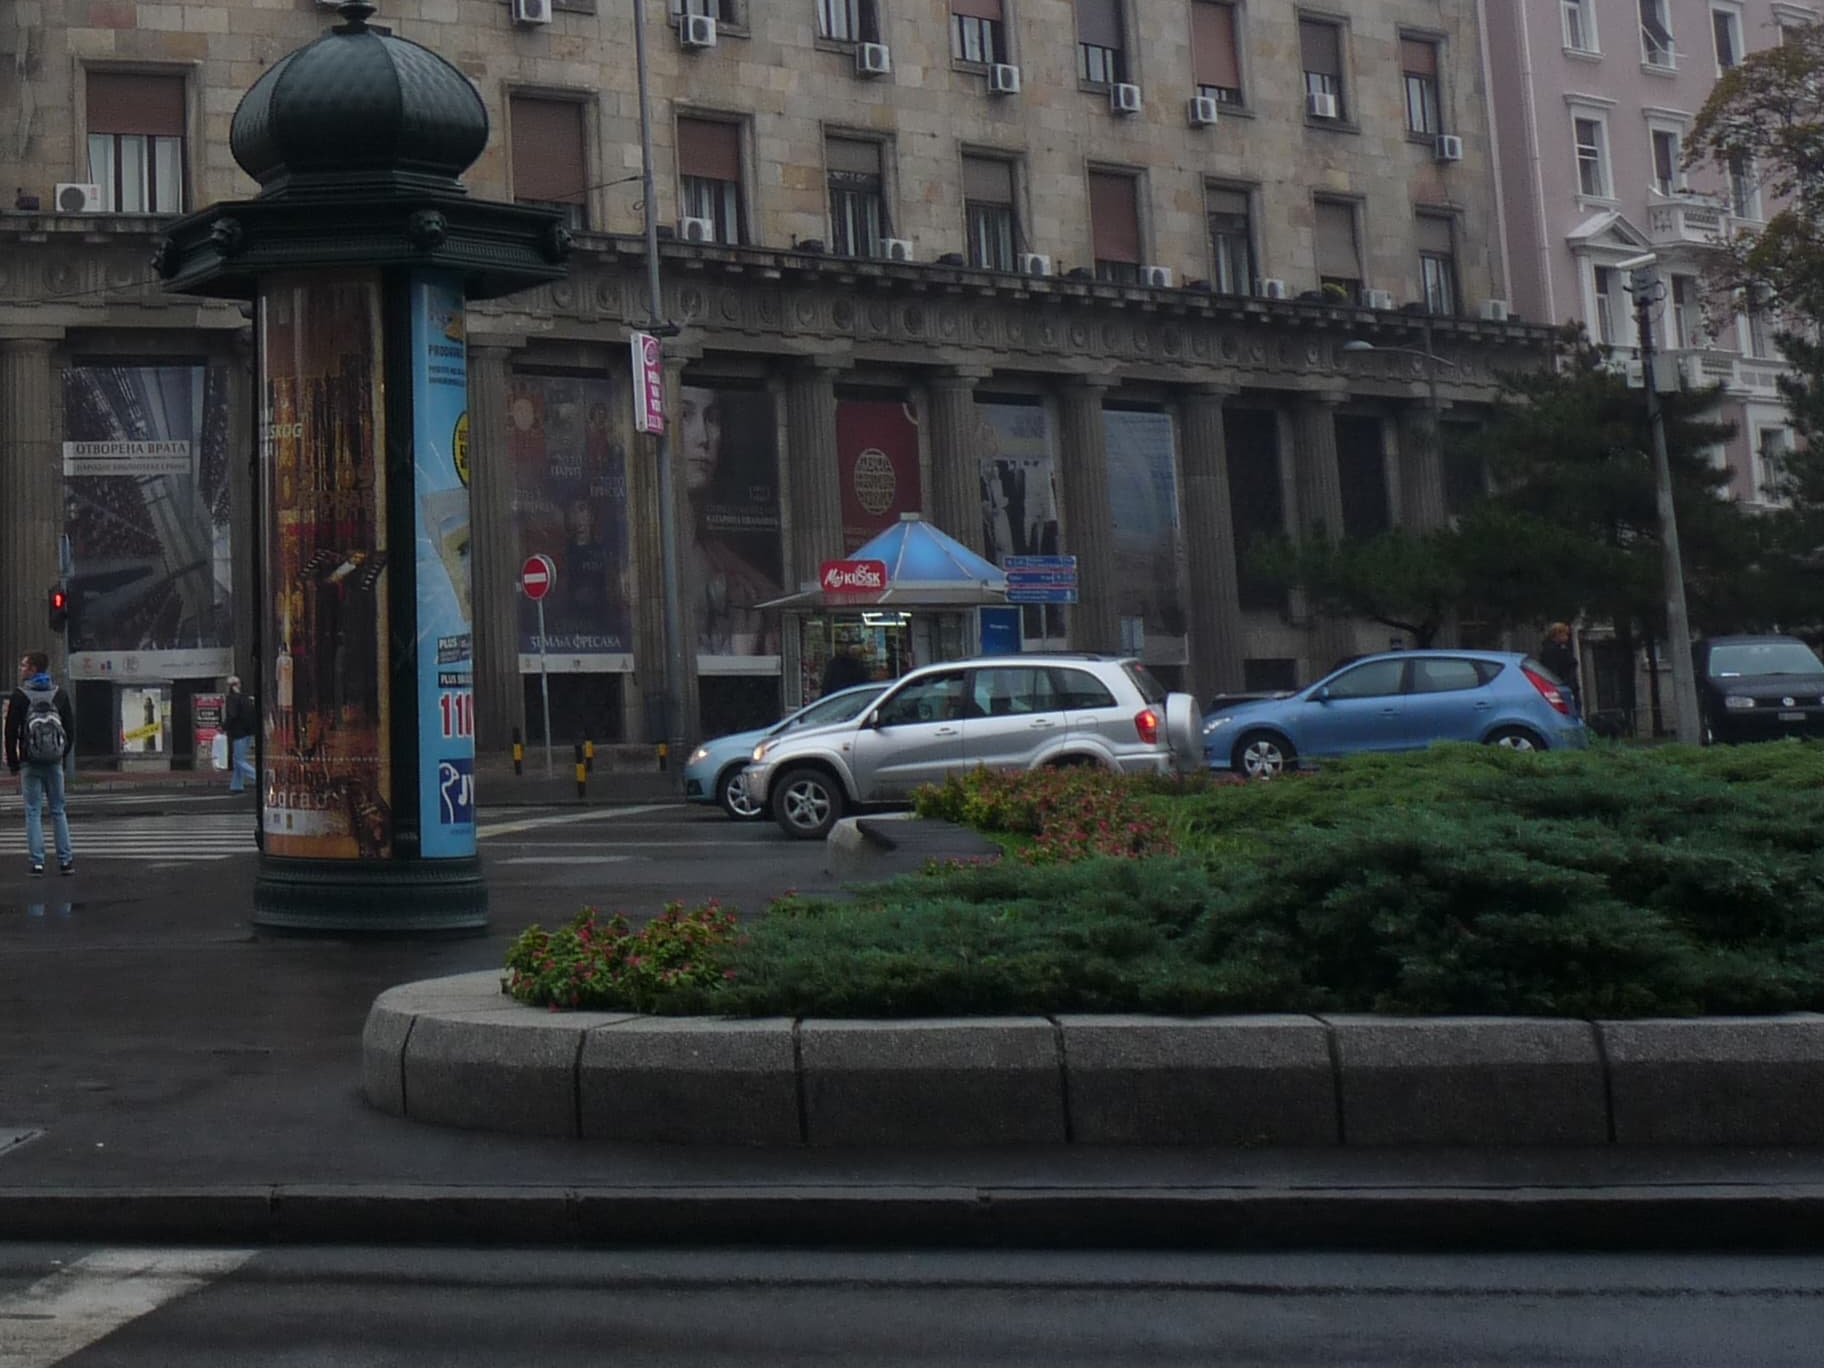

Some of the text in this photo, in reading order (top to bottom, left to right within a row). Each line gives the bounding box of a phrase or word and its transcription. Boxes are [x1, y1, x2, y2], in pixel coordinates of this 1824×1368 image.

[76, 442, 186, 455] ОТВОРЕНА ВРАТА
[844, 565, 881, 587] KIOSK
